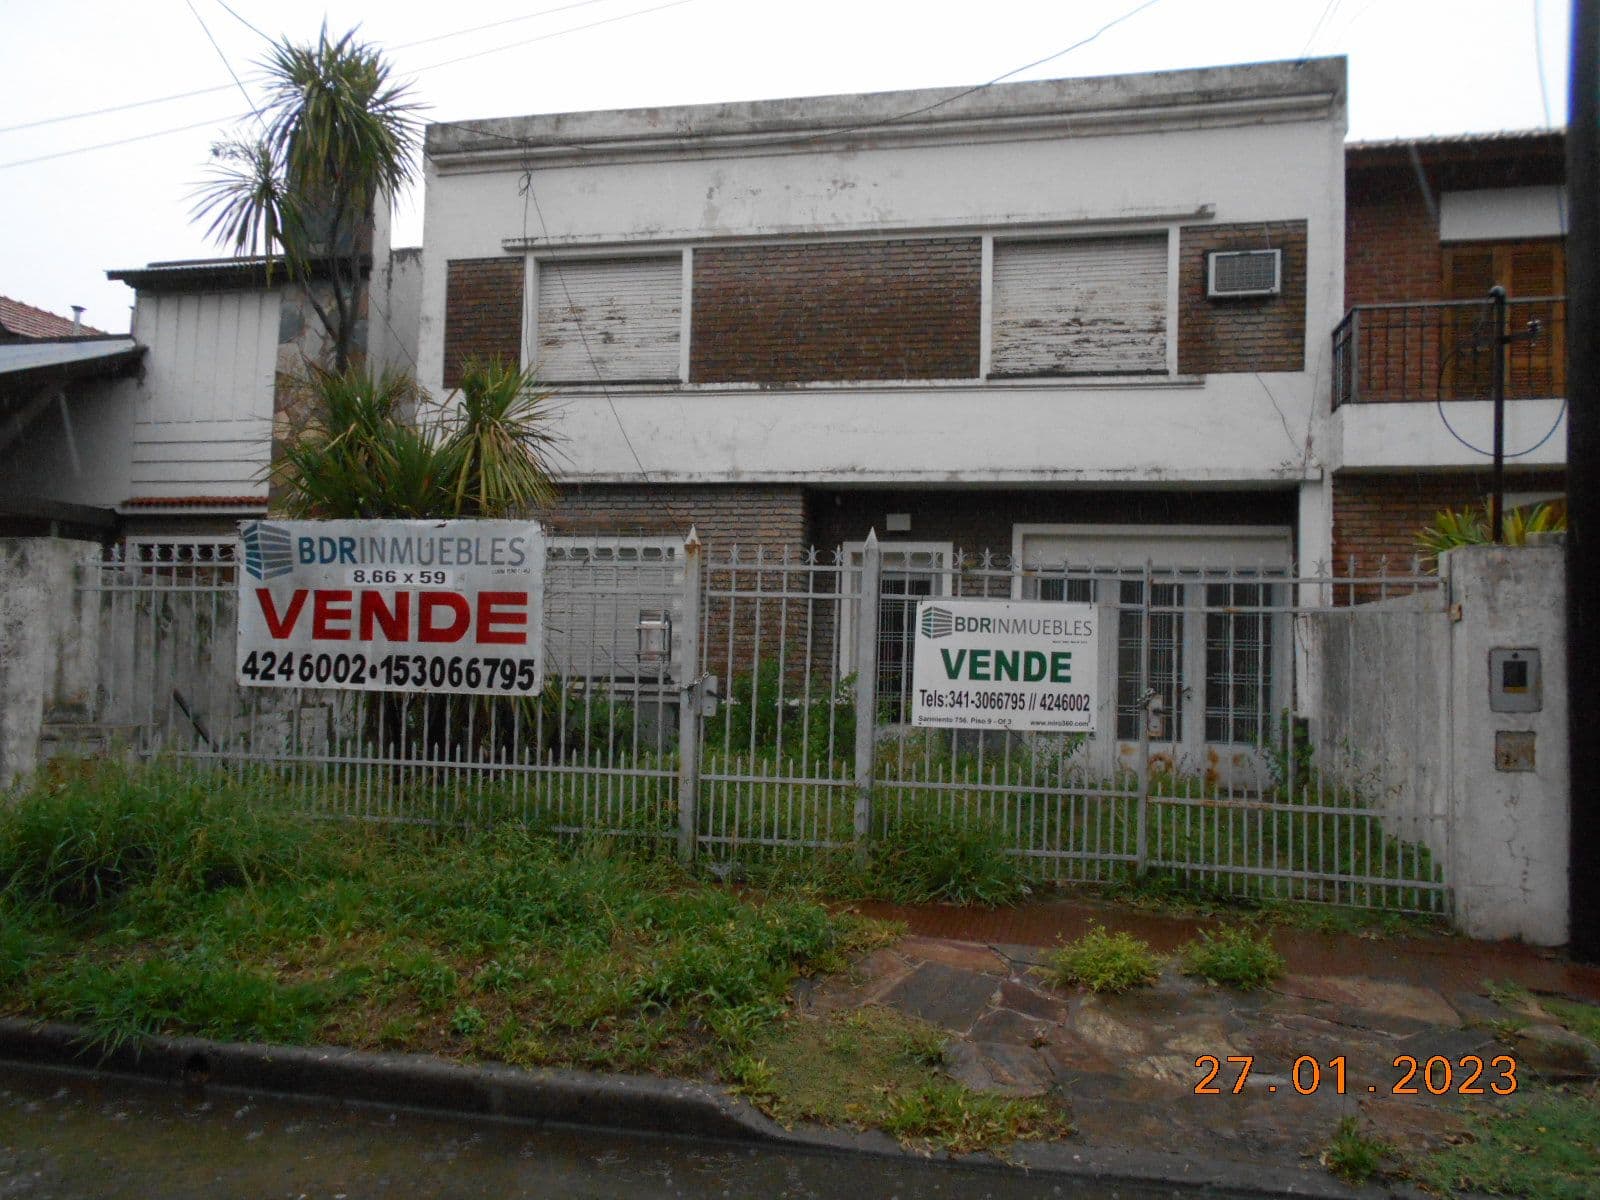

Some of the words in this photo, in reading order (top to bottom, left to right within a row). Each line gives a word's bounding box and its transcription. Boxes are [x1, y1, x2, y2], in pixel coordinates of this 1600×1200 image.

[419, 570, 446, 584] 59
[255, 587, 528, 645] VENDE
[940, 648, 1072, 683] VENDE
[1039, 693, 1091, 713] 4246002
